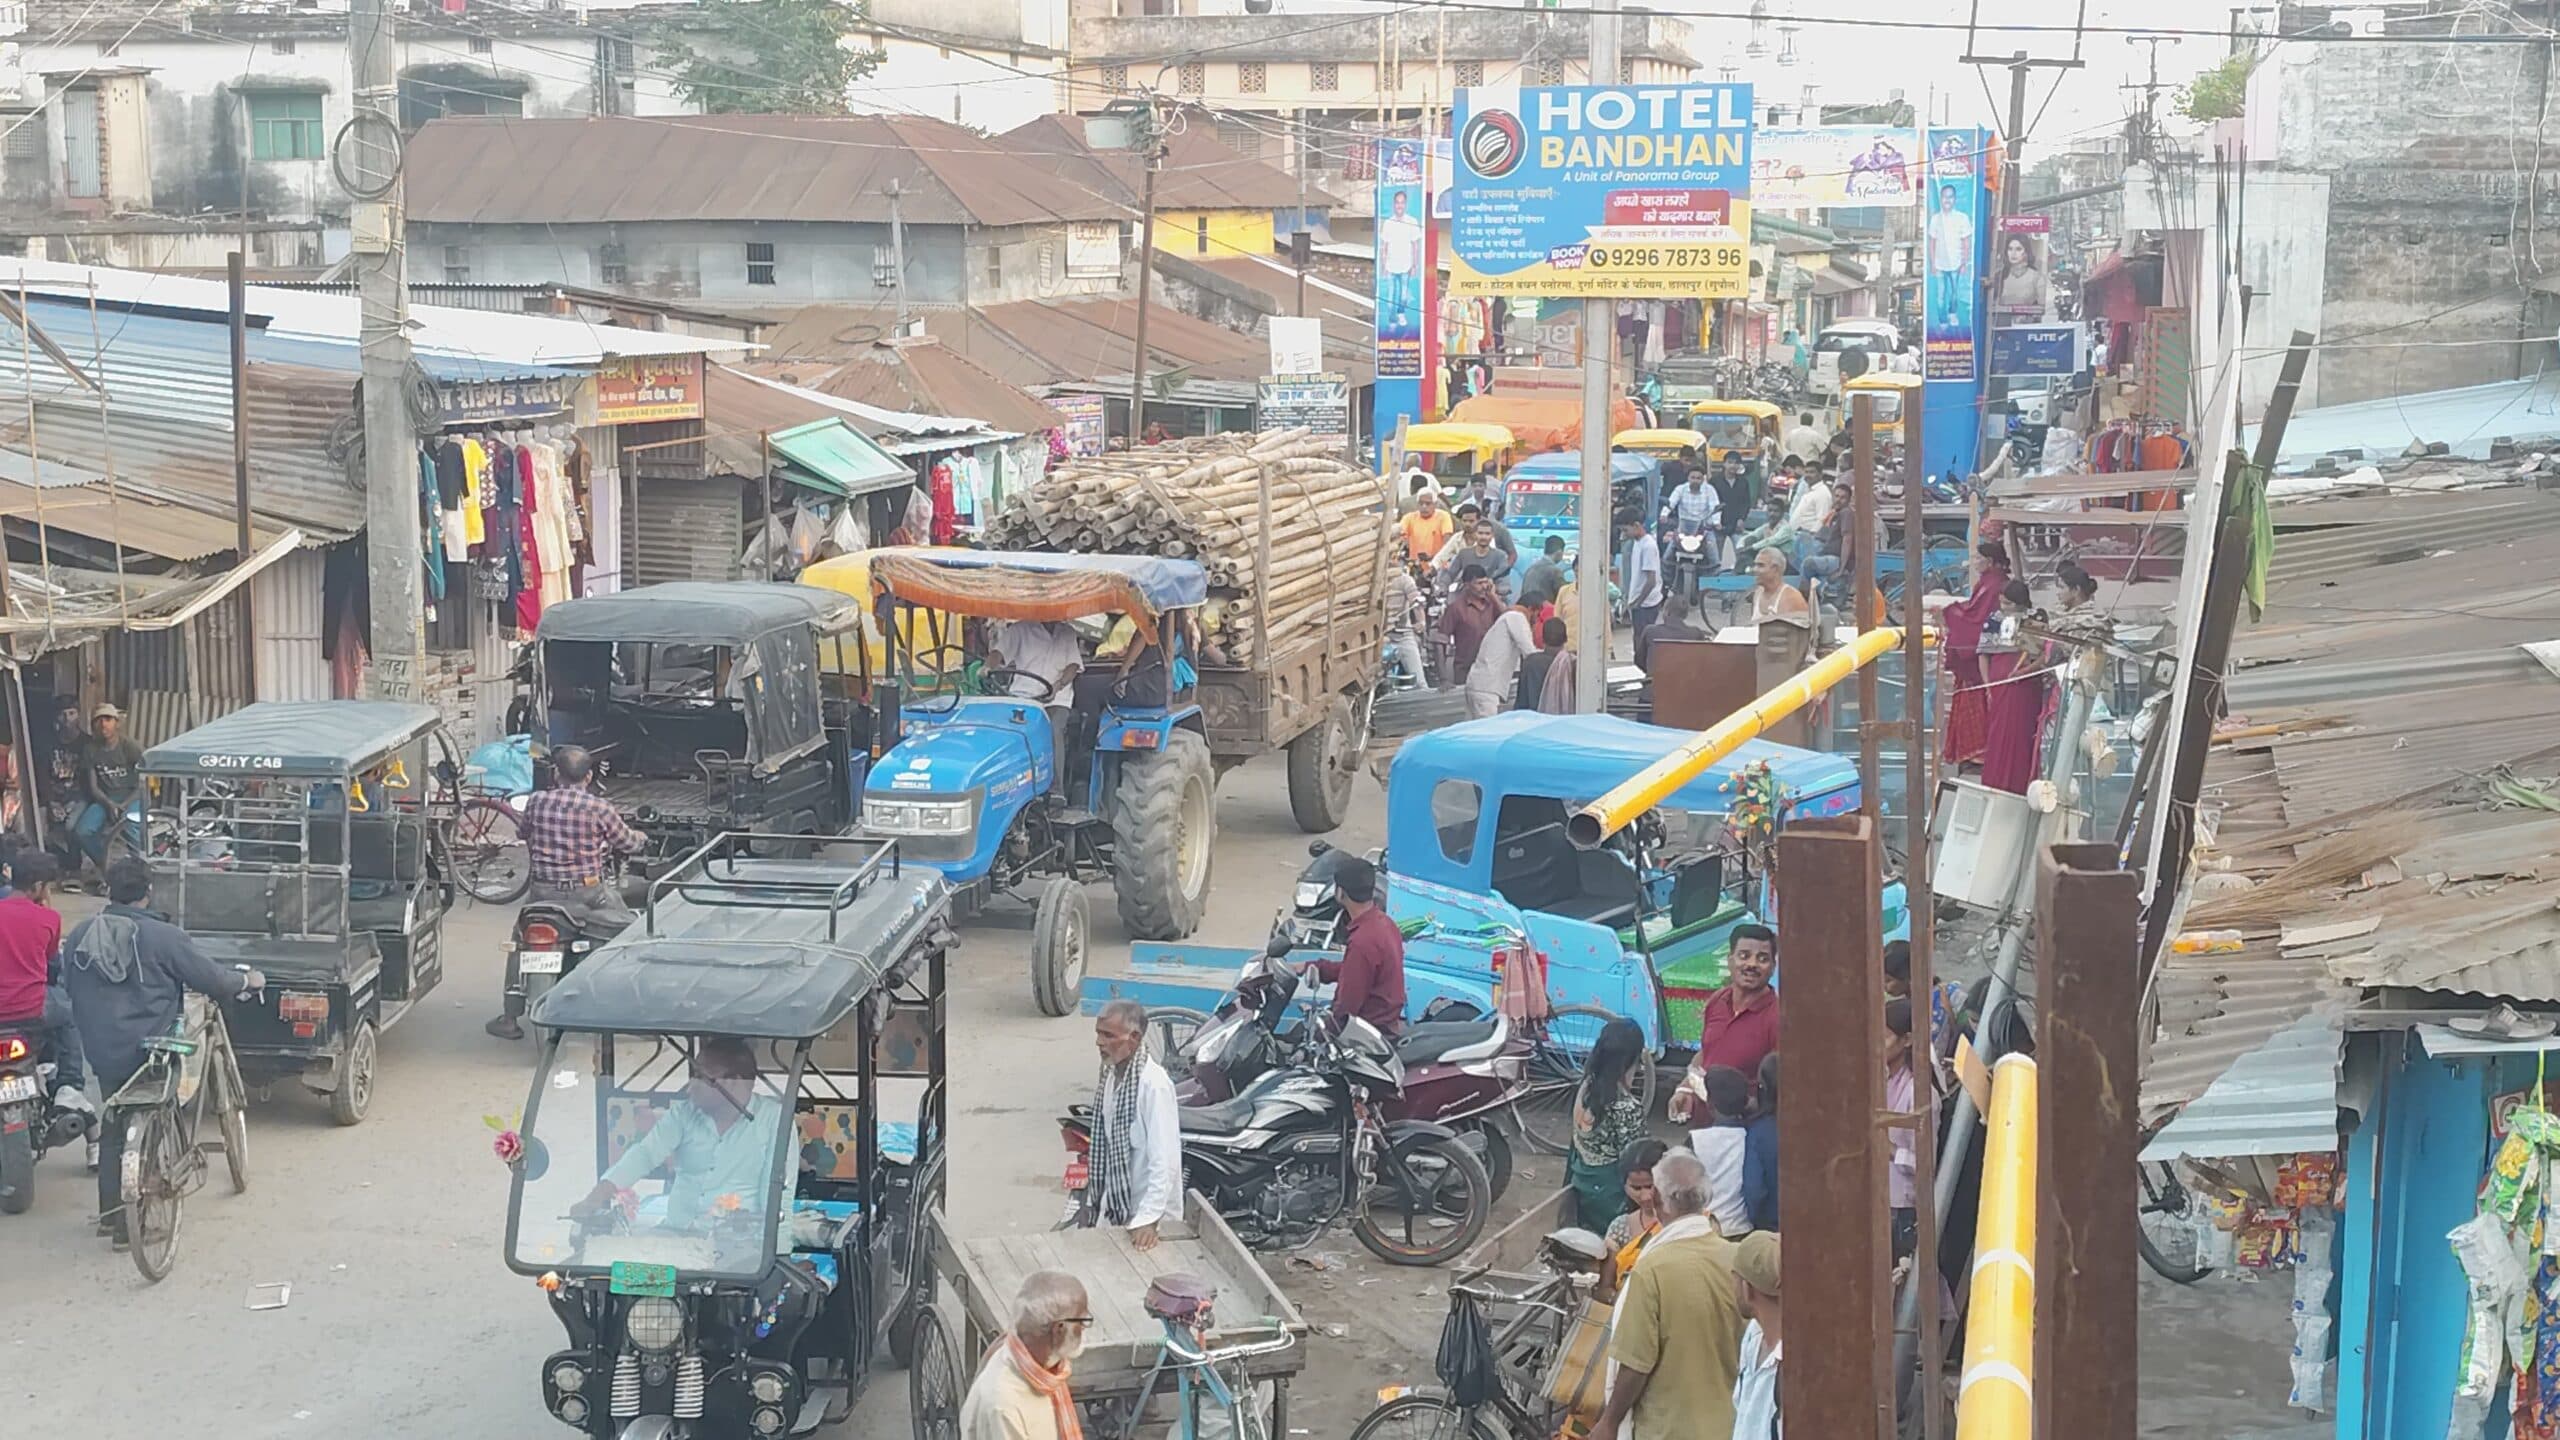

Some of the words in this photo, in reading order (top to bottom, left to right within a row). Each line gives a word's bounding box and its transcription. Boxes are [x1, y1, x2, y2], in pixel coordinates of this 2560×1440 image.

[1538, 89, 1747, 131] HOTEL
[1540, 133, 1744, 169] BANDHAN
[1562, 171, 1572, 183] A
[1574, 170, 1599, 182] Unit
[1600, 170, 1613, 182] of
[1615, 169, 1679, 182] Panorama
[1681, 168, 1720, 184] Group
[1613, 193, 1638, 207] अपने
[1640, 194, 1663, 207] खास
[1643, 208, 1657, 222] को
[1551, 246, 1585, 259] BOOK
[1612, 249, 1660, 266] 9296
[1664, 249, 1711, 266] 7873
[1717, 249, 1741, 266] 96
[1555, 260, 1581, 269] NOW
[2027, 333, 2057, 342] FLITE
[252, 756, 283, 769] CAB
